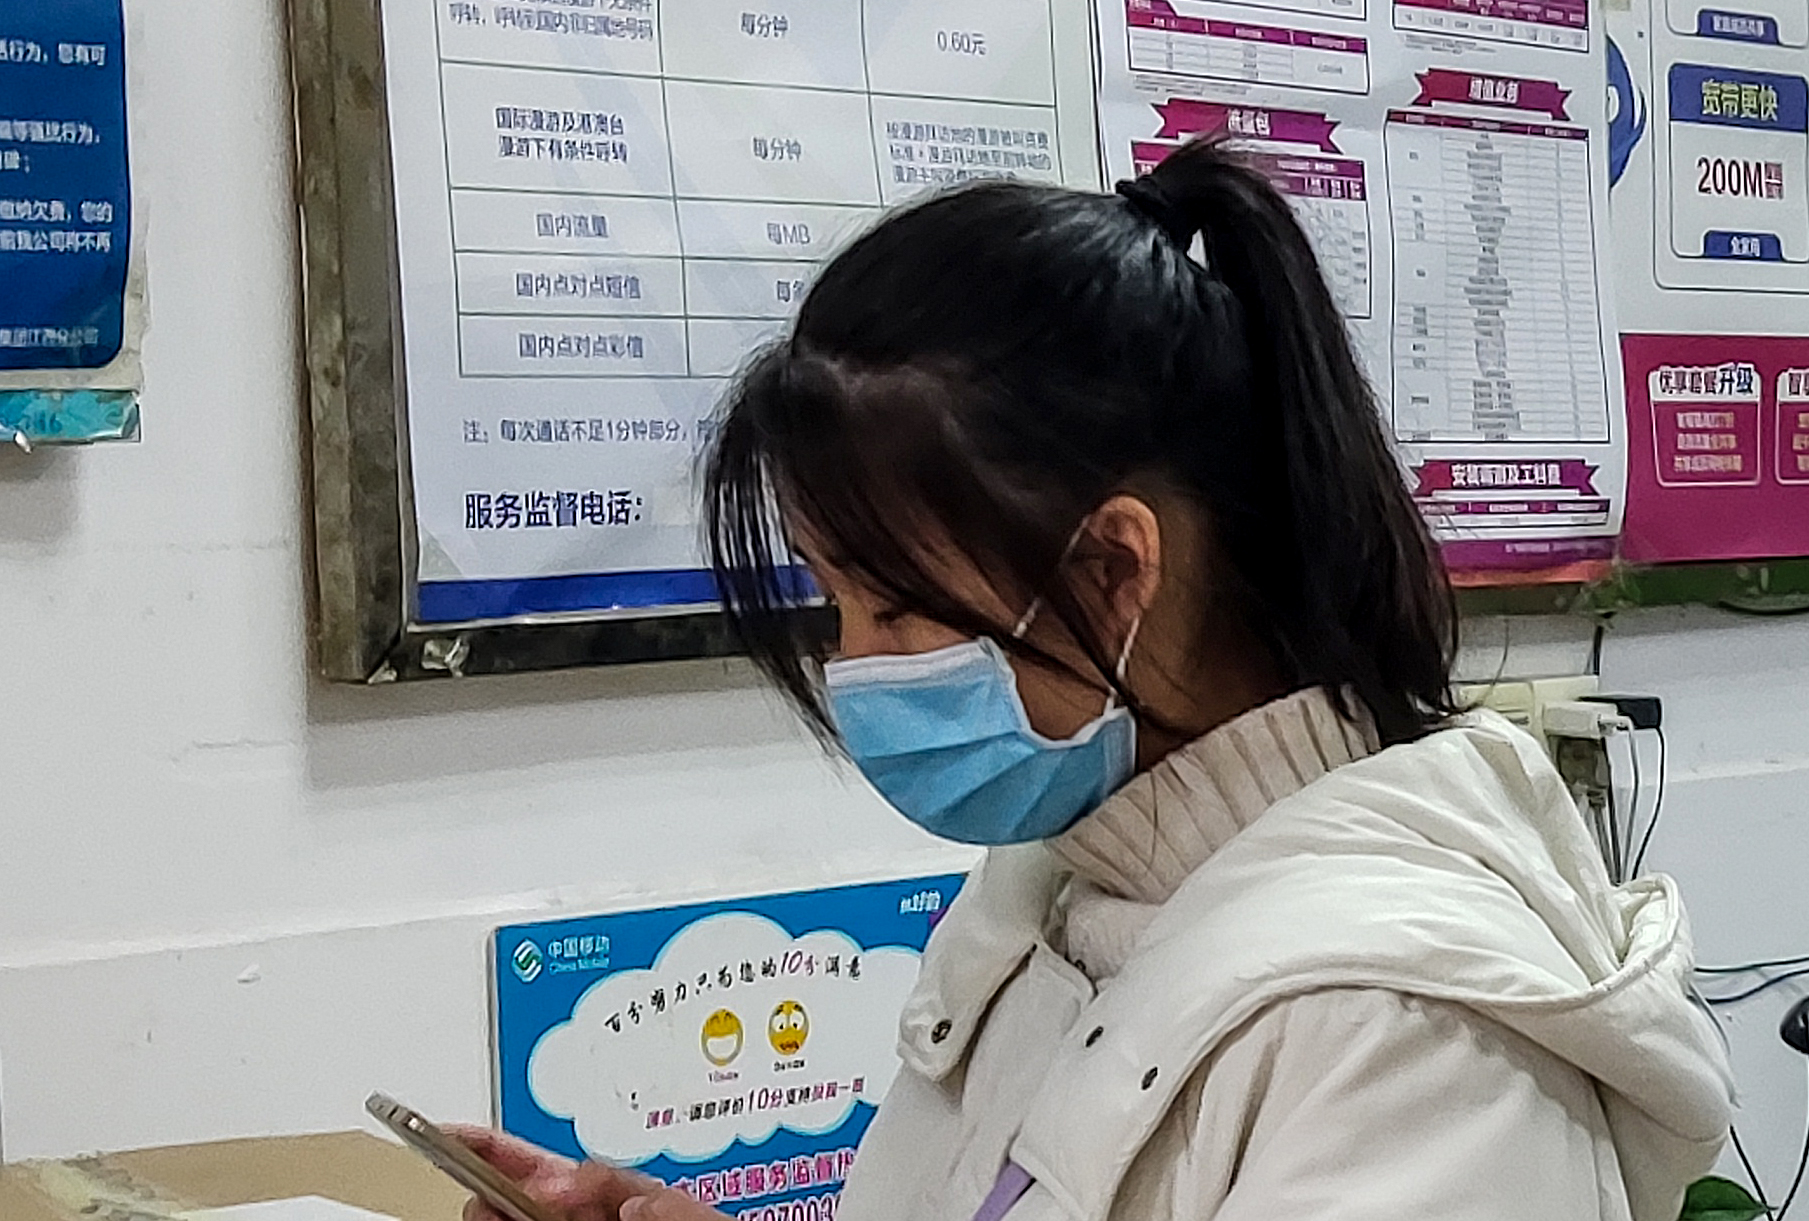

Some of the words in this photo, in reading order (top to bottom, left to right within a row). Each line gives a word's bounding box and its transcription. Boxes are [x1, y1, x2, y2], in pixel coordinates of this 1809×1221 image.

[536, 211, 609, 239] 国内流量
[515, 272, 641, 300] 国内点对点短信
